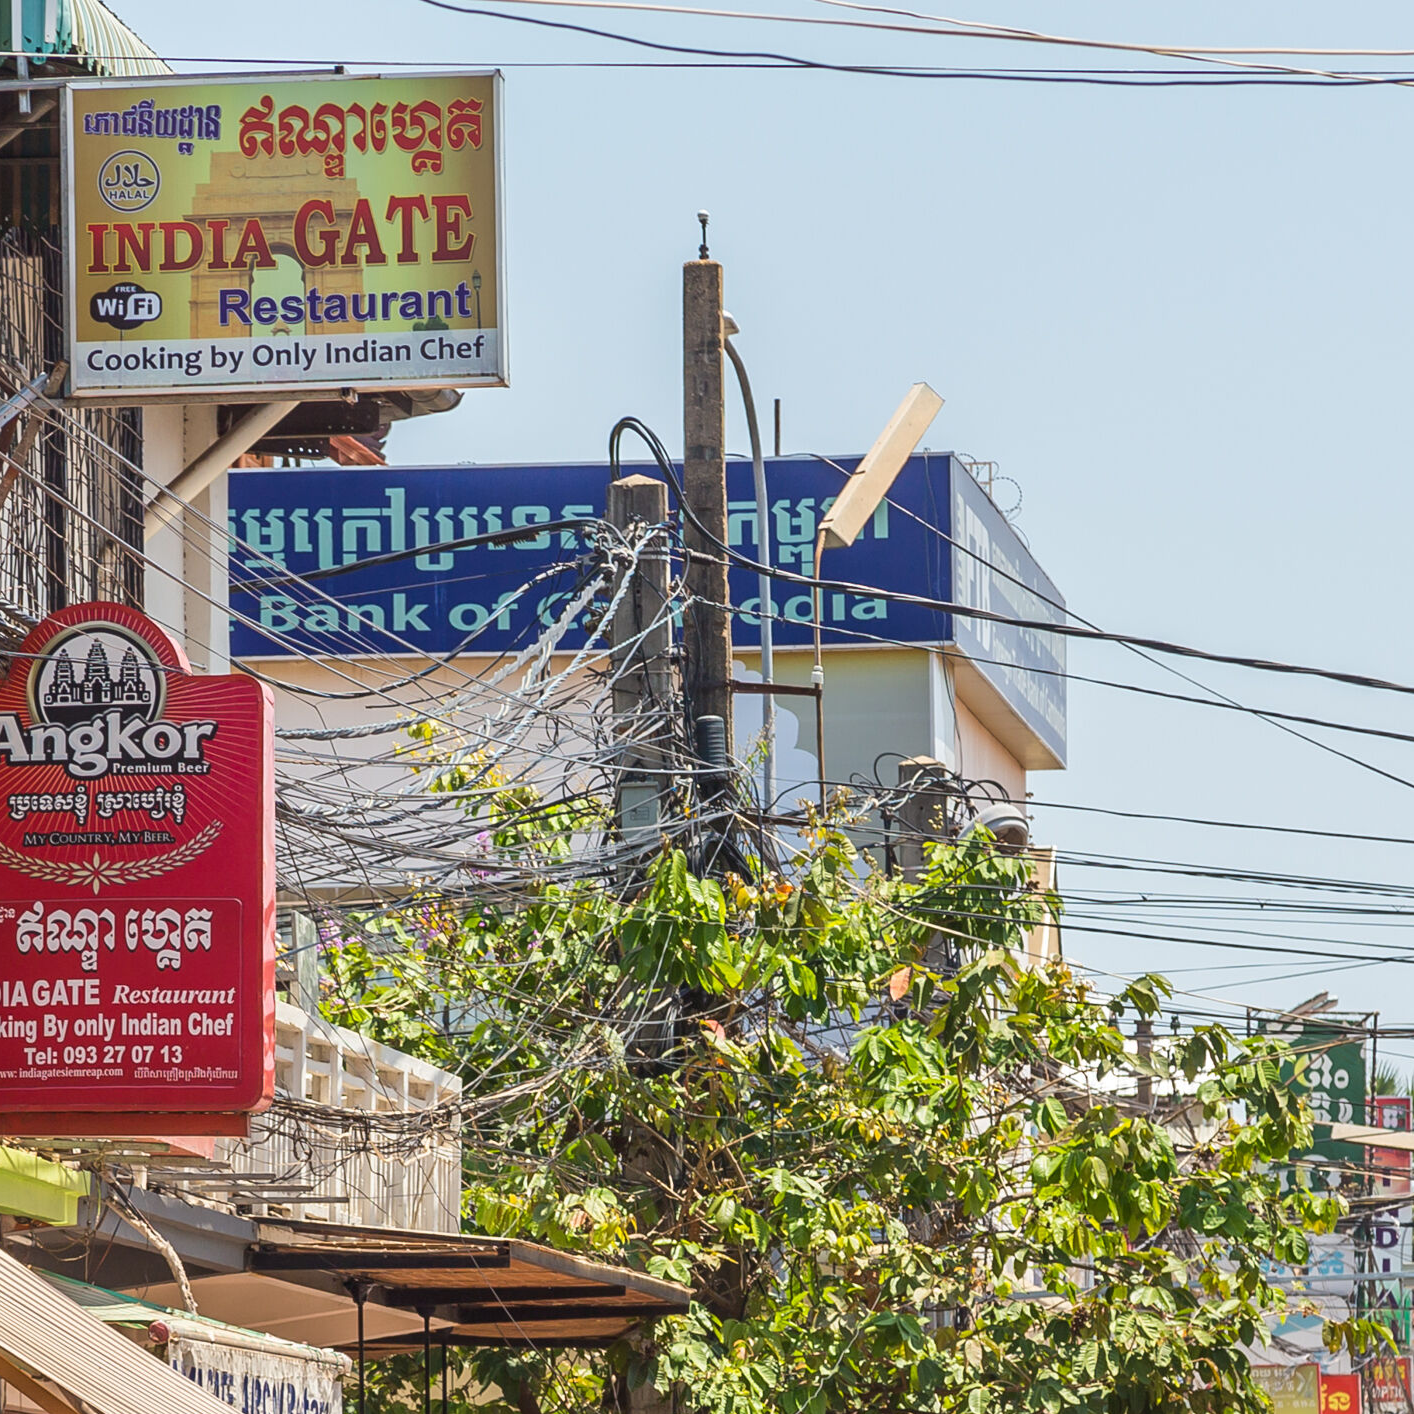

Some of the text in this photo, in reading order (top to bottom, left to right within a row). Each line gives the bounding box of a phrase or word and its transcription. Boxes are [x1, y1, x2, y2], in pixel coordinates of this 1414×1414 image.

[108, 188, 150, 201] HALAL
[87, 193, 476, 273] INDIA GATE
[114, 285, 136, 293] FREE
[218, 281, 473, 326] Restaurant
[87, 335, 485, 376] Cooking by Only Indian Chef
[259, 592, 432, 633] Bank
[448, 590, 519, 632] of
[112, 760, 210, 775] Premium Beer
[32, 978, 100, 1008] GATE
[112, 984, 237, 1006] Restaurant
[43, 1014, 69, 1042] By
[73, 1013, 116, 1042] only
[121, 1012, 182, 1037] Indian
[187, 1012, 234, 1036] Chef
[24, 1045, 183, 1066] Tel: 093 27 07 13
[19, 1066, 124, 1082] indiagatesiemreap.com
